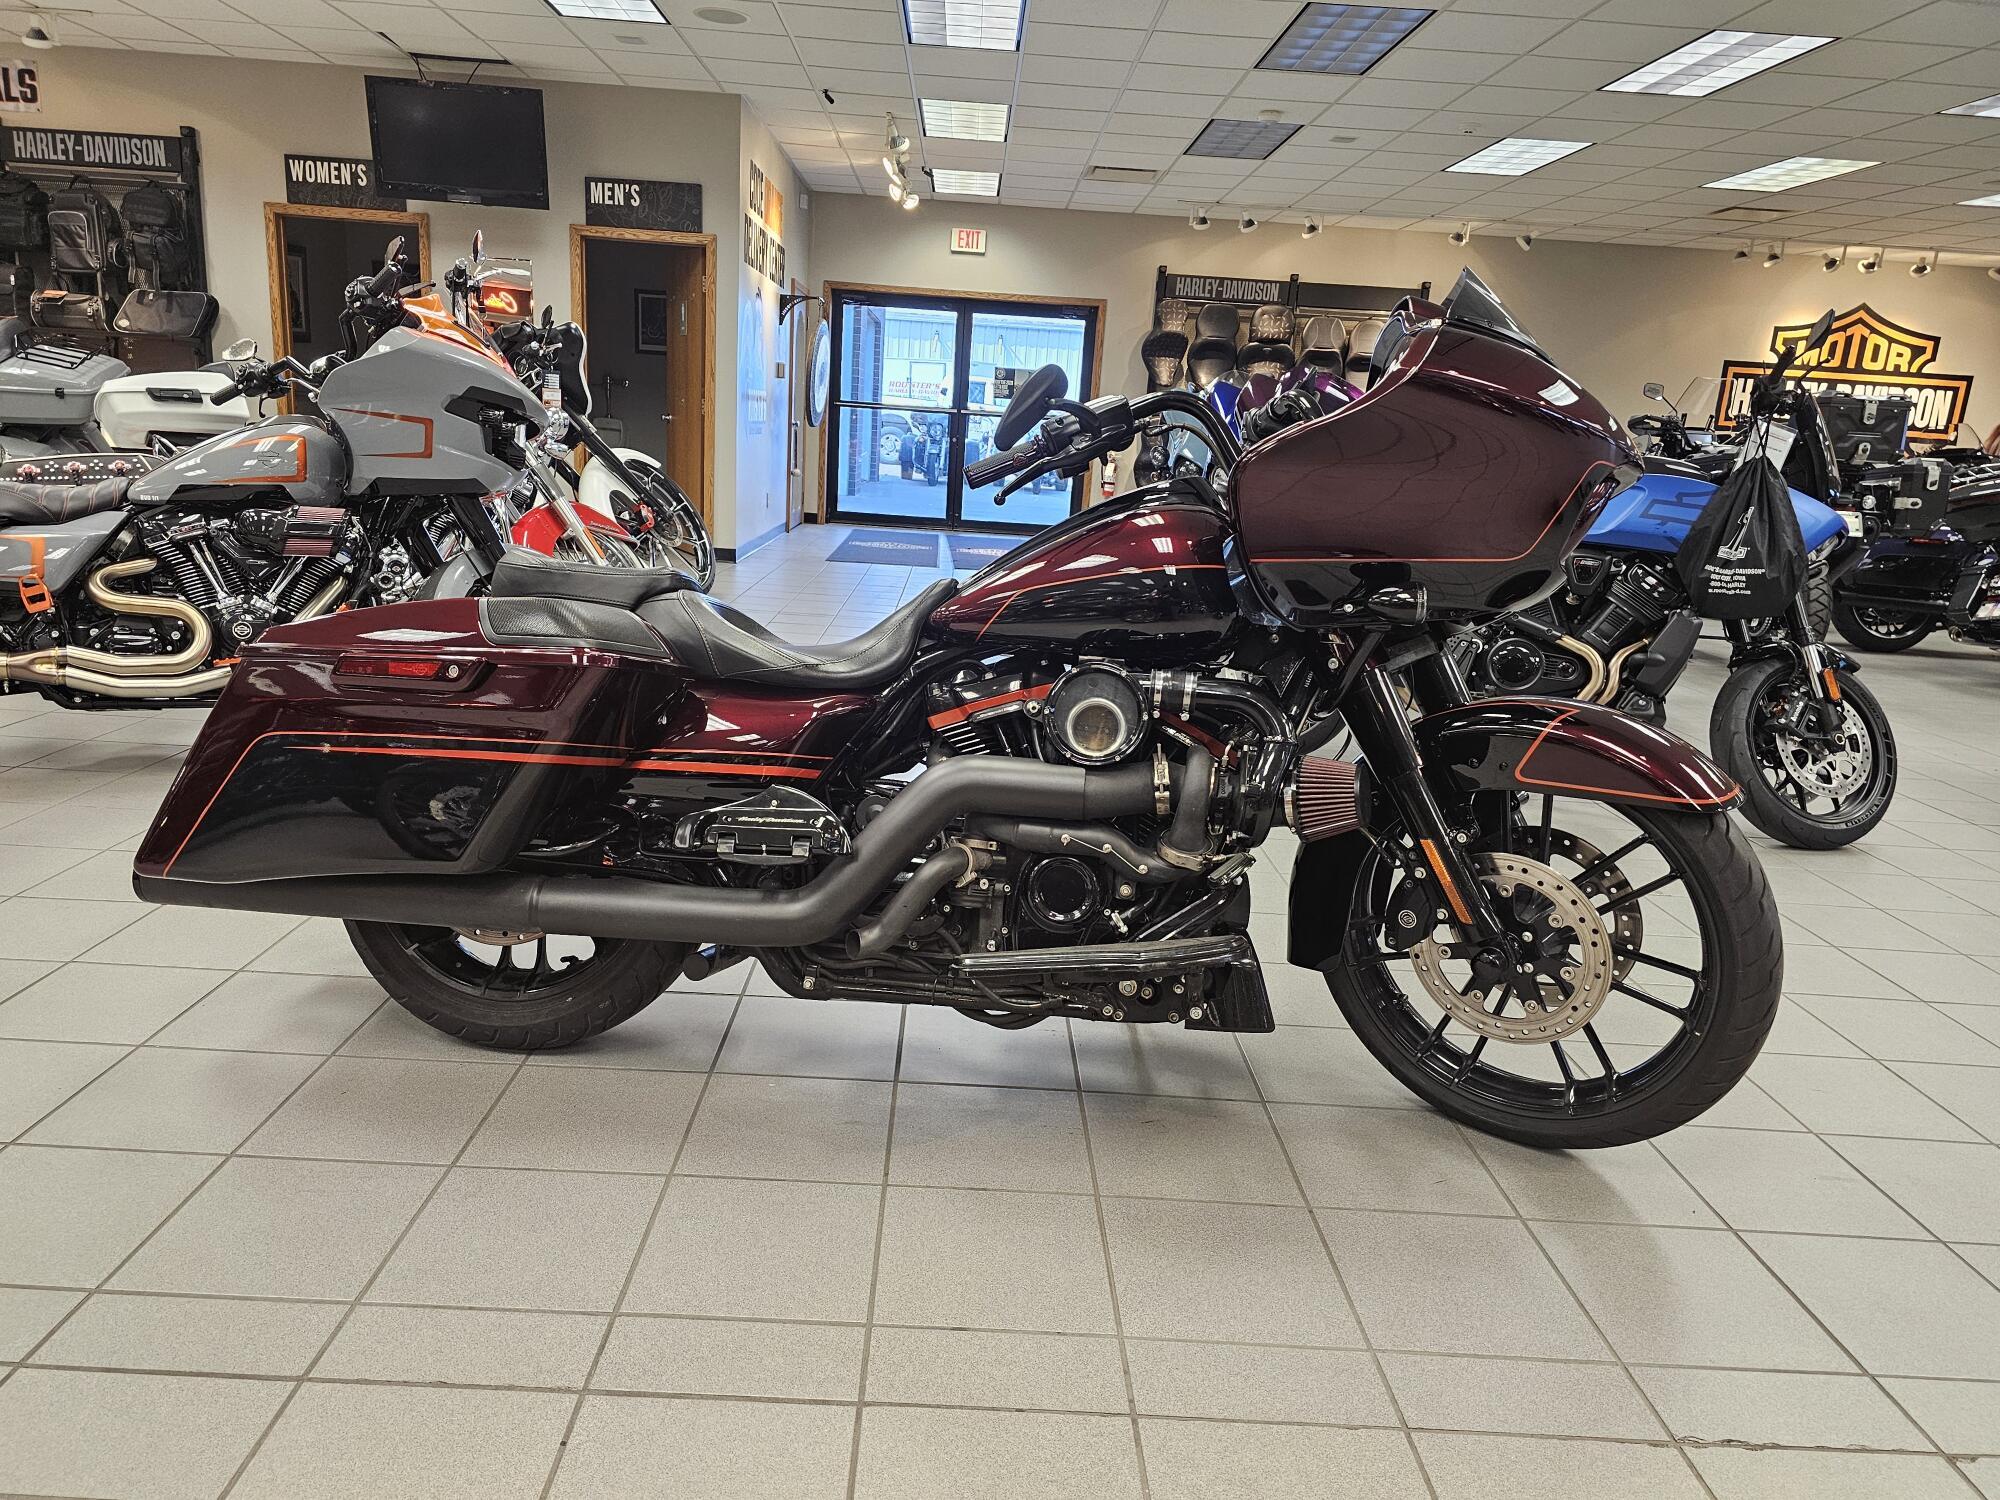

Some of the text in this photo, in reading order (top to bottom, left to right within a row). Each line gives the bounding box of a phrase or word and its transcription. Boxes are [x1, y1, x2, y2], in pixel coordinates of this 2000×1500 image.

[0, 67, 38, 103] LS
[13, 131, 167, 167] HARLEY-DAVIDSON
[289, 159, 368, 187] WOMEN'S
[590, 182, 640, 207] MEN'S
[957, 230, 981, 249] EXIT
[1175, 277, 1280, 302] HARLEY-DAVIDSON
